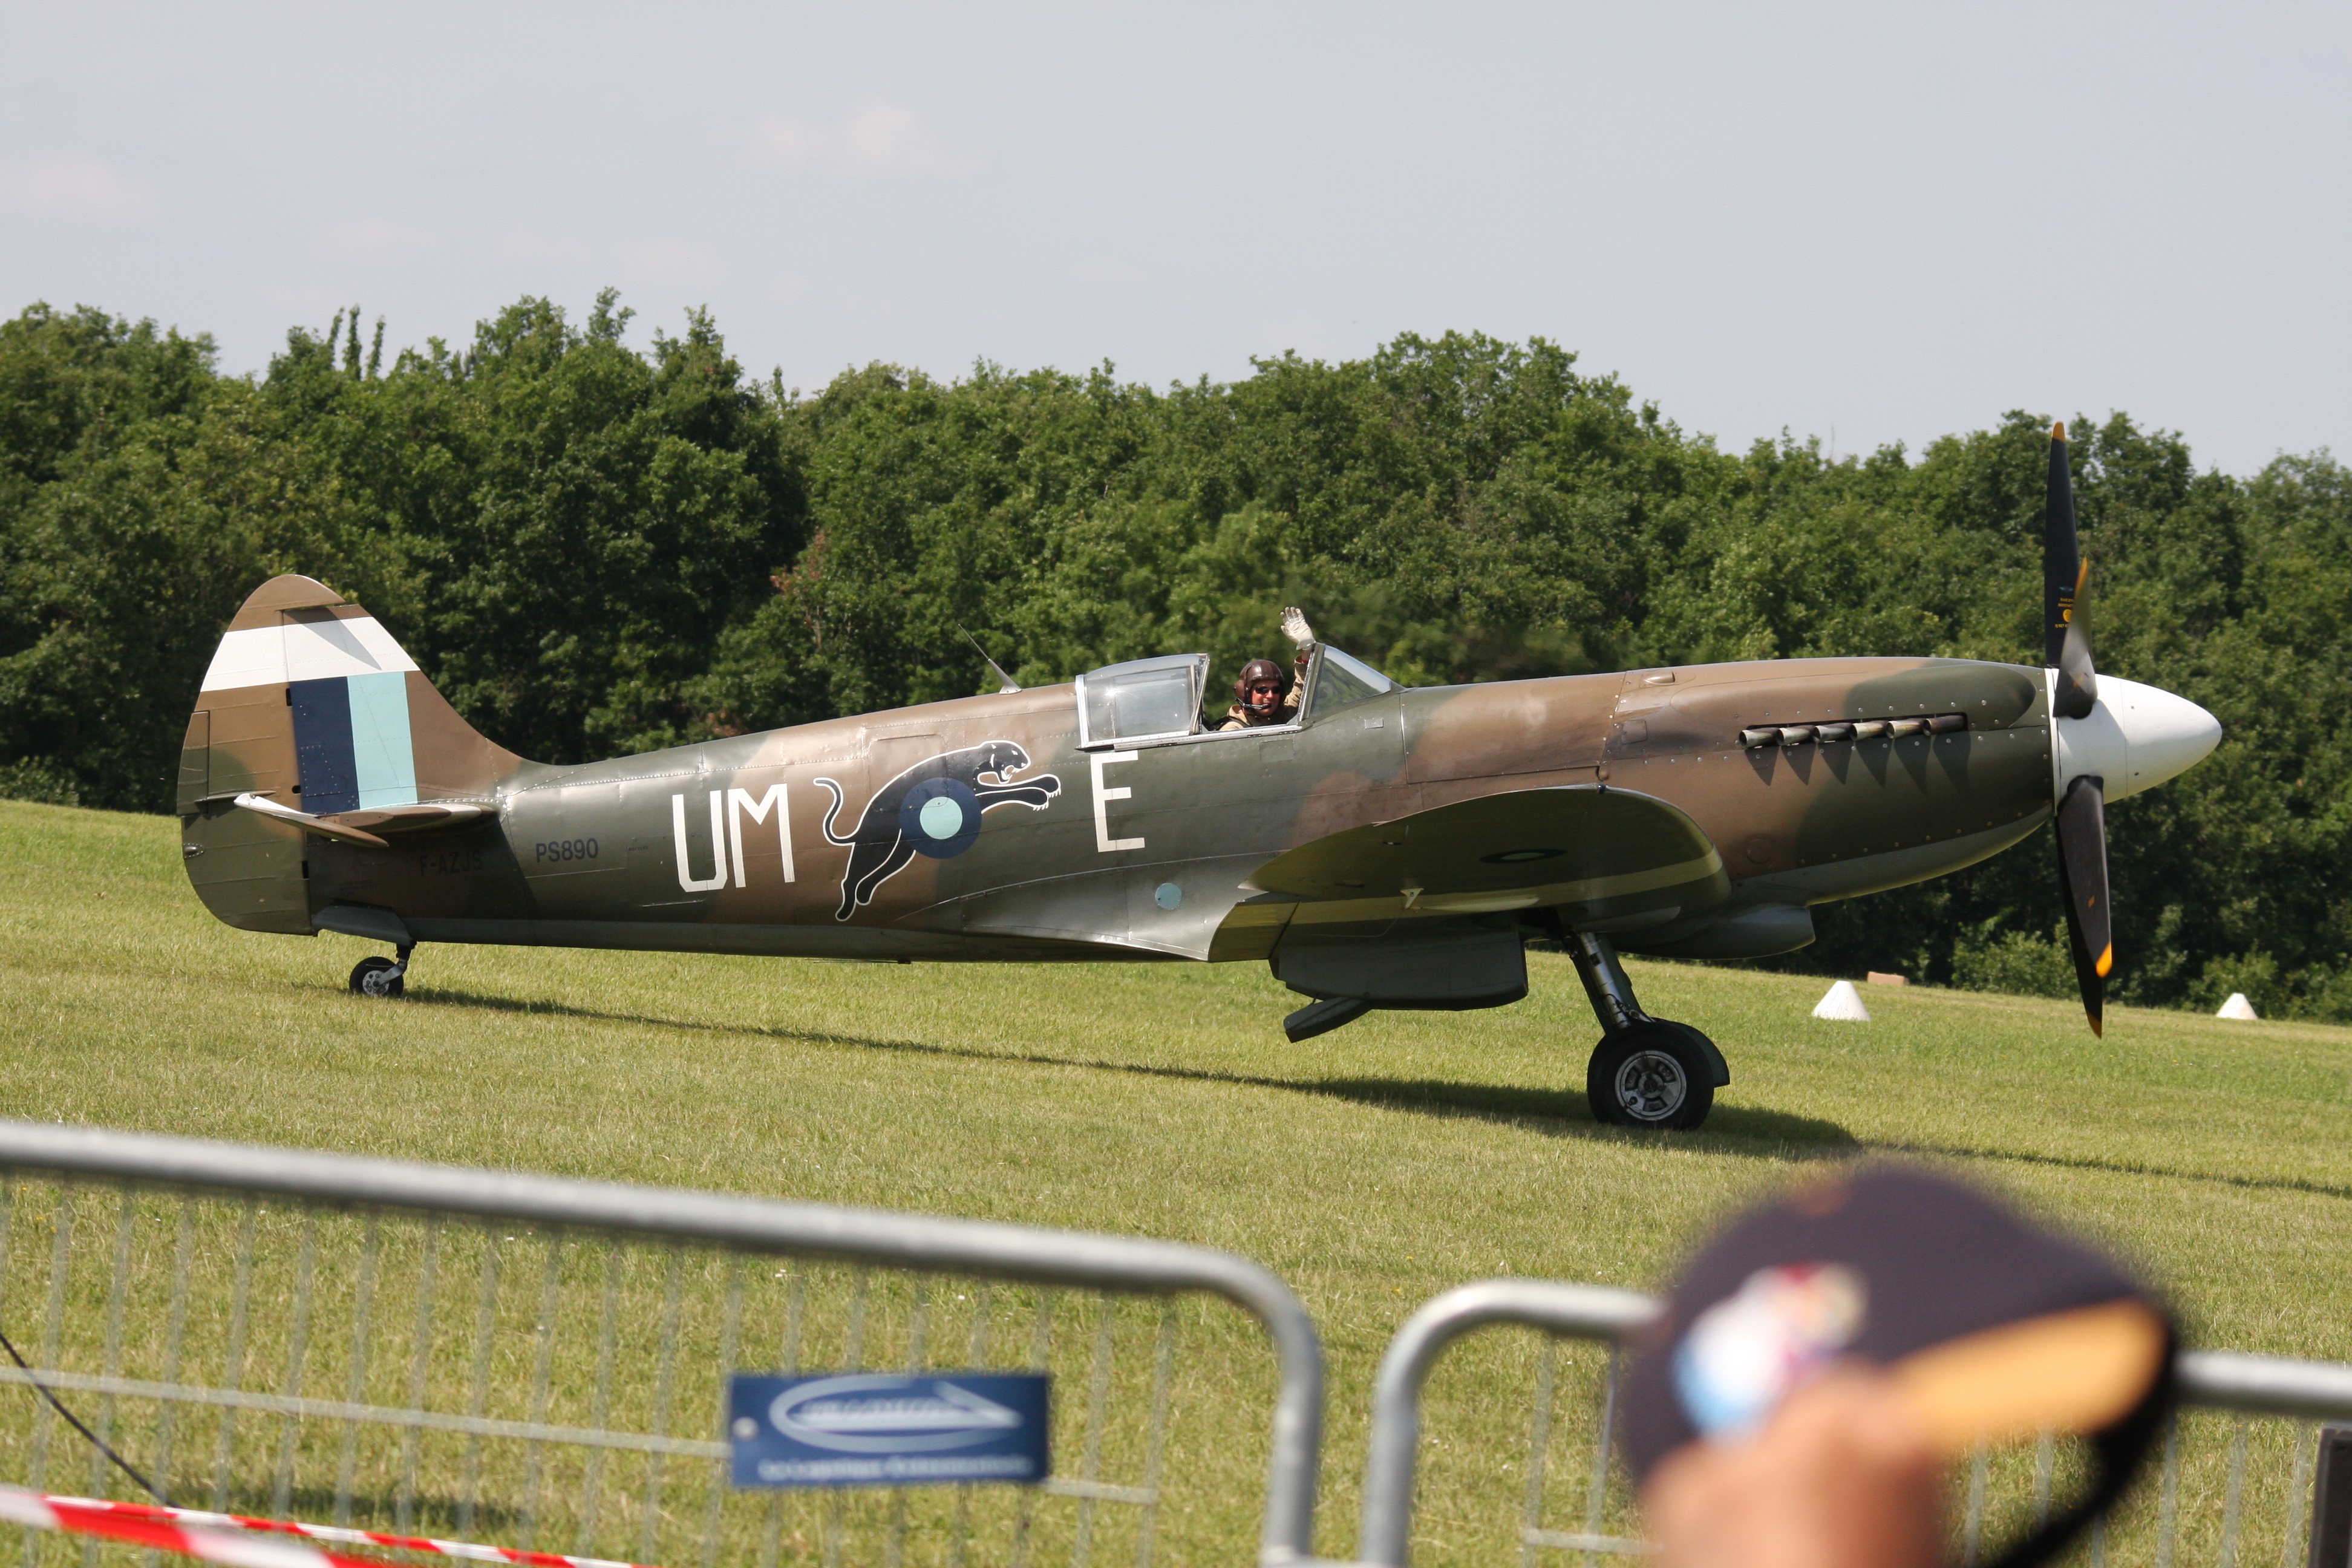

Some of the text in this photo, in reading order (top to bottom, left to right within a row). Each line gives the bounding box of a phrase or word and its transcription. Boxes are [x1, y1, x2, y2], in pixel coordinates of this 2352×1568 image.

[1089, 750, 1146, 853] E
[419, 849, 483, 877] F-AZJS
[535, 837, 599, 864] PS890
[672, 783, 795, 893] UM
